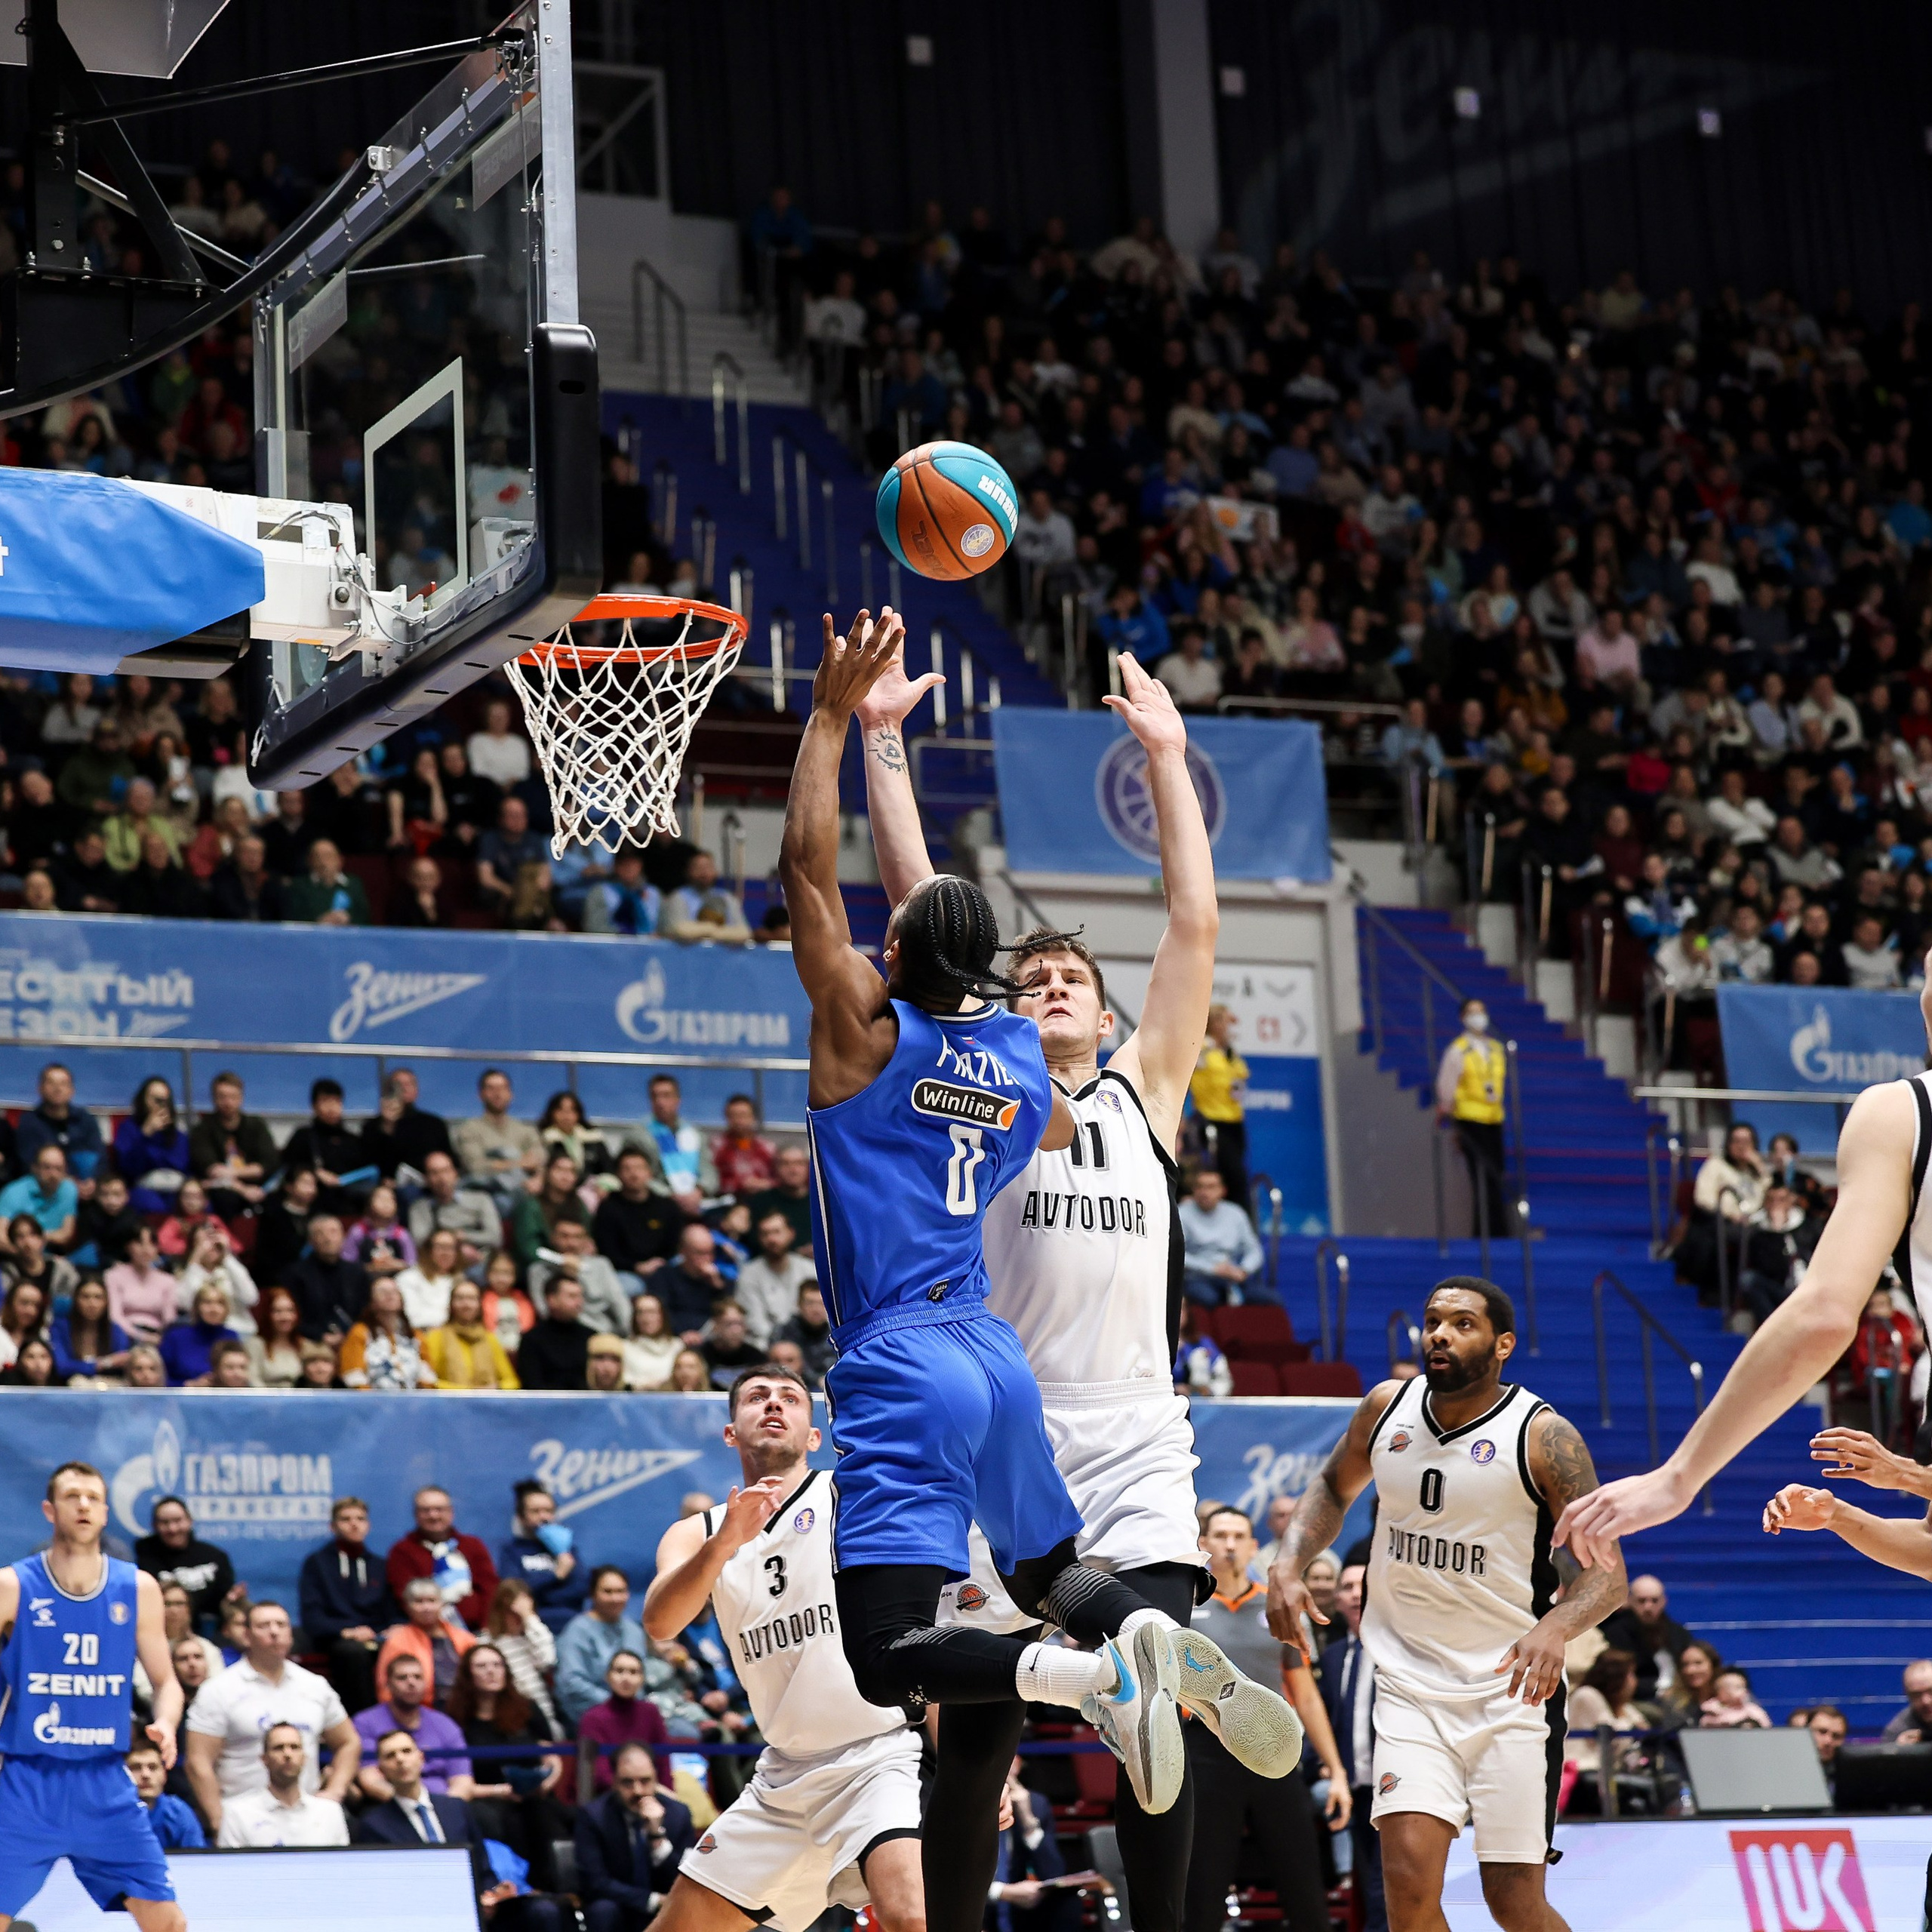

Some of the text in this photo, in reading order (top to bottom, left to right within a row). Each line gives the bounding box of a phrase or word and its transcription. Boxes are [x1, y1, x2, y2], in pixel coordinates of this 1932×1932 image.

[936, 1034, 1020, 1087] FRAZIE
[923, 1085, 995, 1119] Winline
[1069, 1121, 1110, 1172] 11
[946, 1124, 986, 1217] 0
[1020, 1189, 1148, 1238] AVTODOR
[185, 1454, 332, 1494] ГАЗПРОМ
[1420, 1468, 1445, 1515] 0
[764, 1555, 788, 1599] 3
[62, 1632, 99, 1666] 20
[739, 1604, 836, 1664] AVTODOR
[27, 1672, 125, 1697] ZENIT
